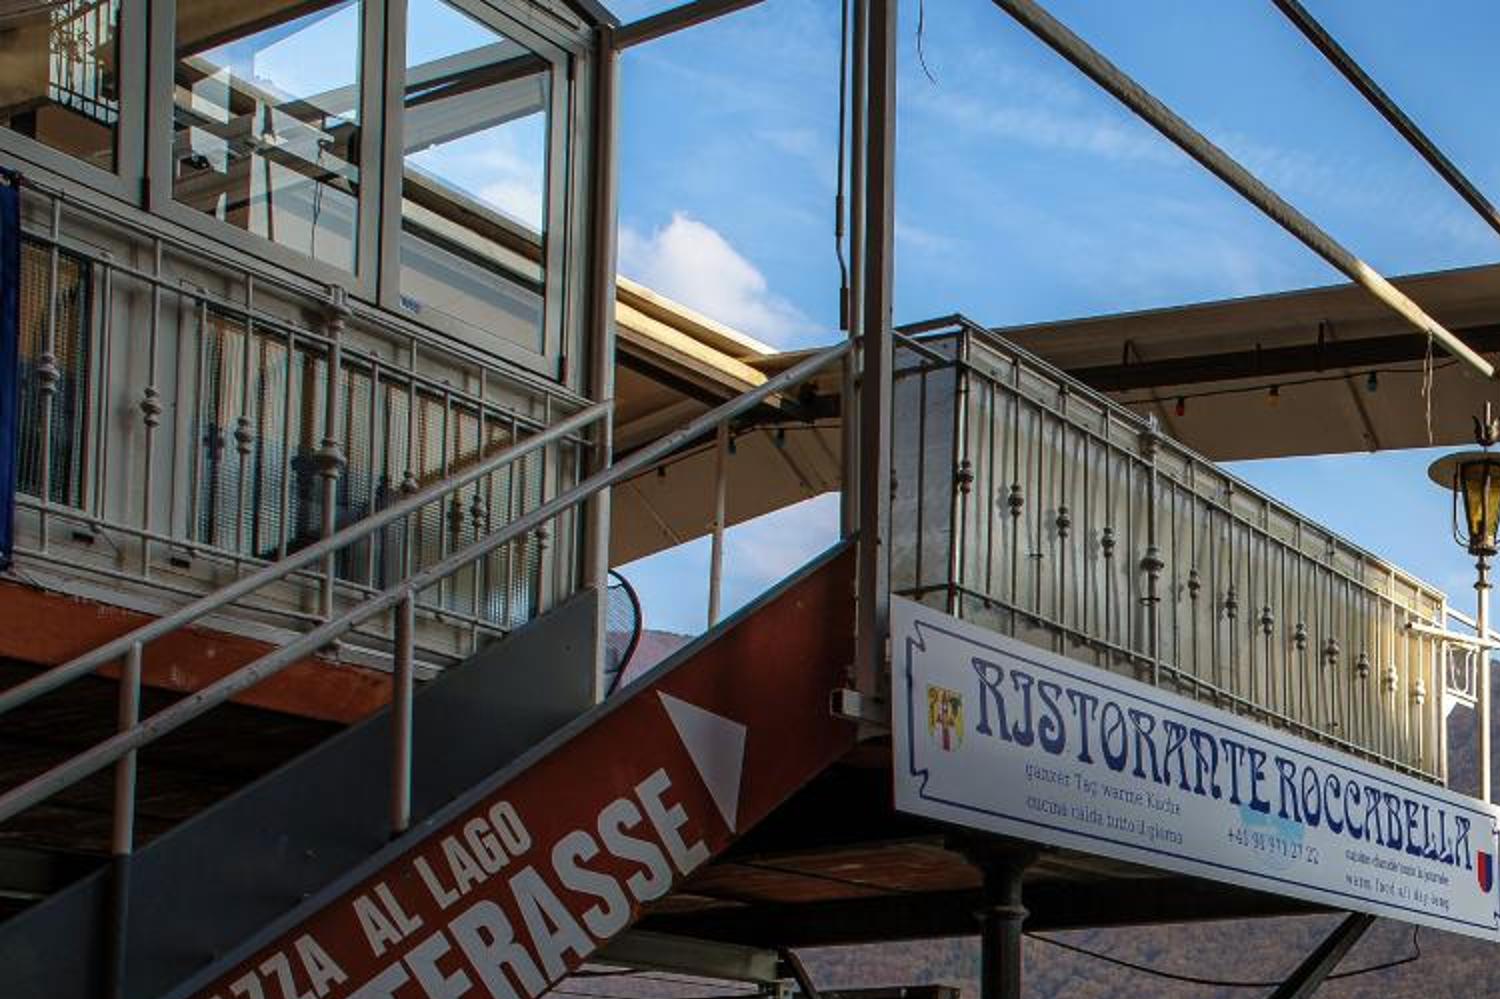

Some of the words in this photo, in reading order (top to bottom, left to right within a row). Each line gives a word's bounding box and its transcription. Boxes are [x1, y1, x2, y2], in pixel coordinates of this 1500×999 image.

[971, 656, 1272, 815] RISTORANTE
[1277, 756, 1475, 872] ROCCABELLA
[353, 887, 423, 957] AL
[414, 800, 533, 913] LAGO
